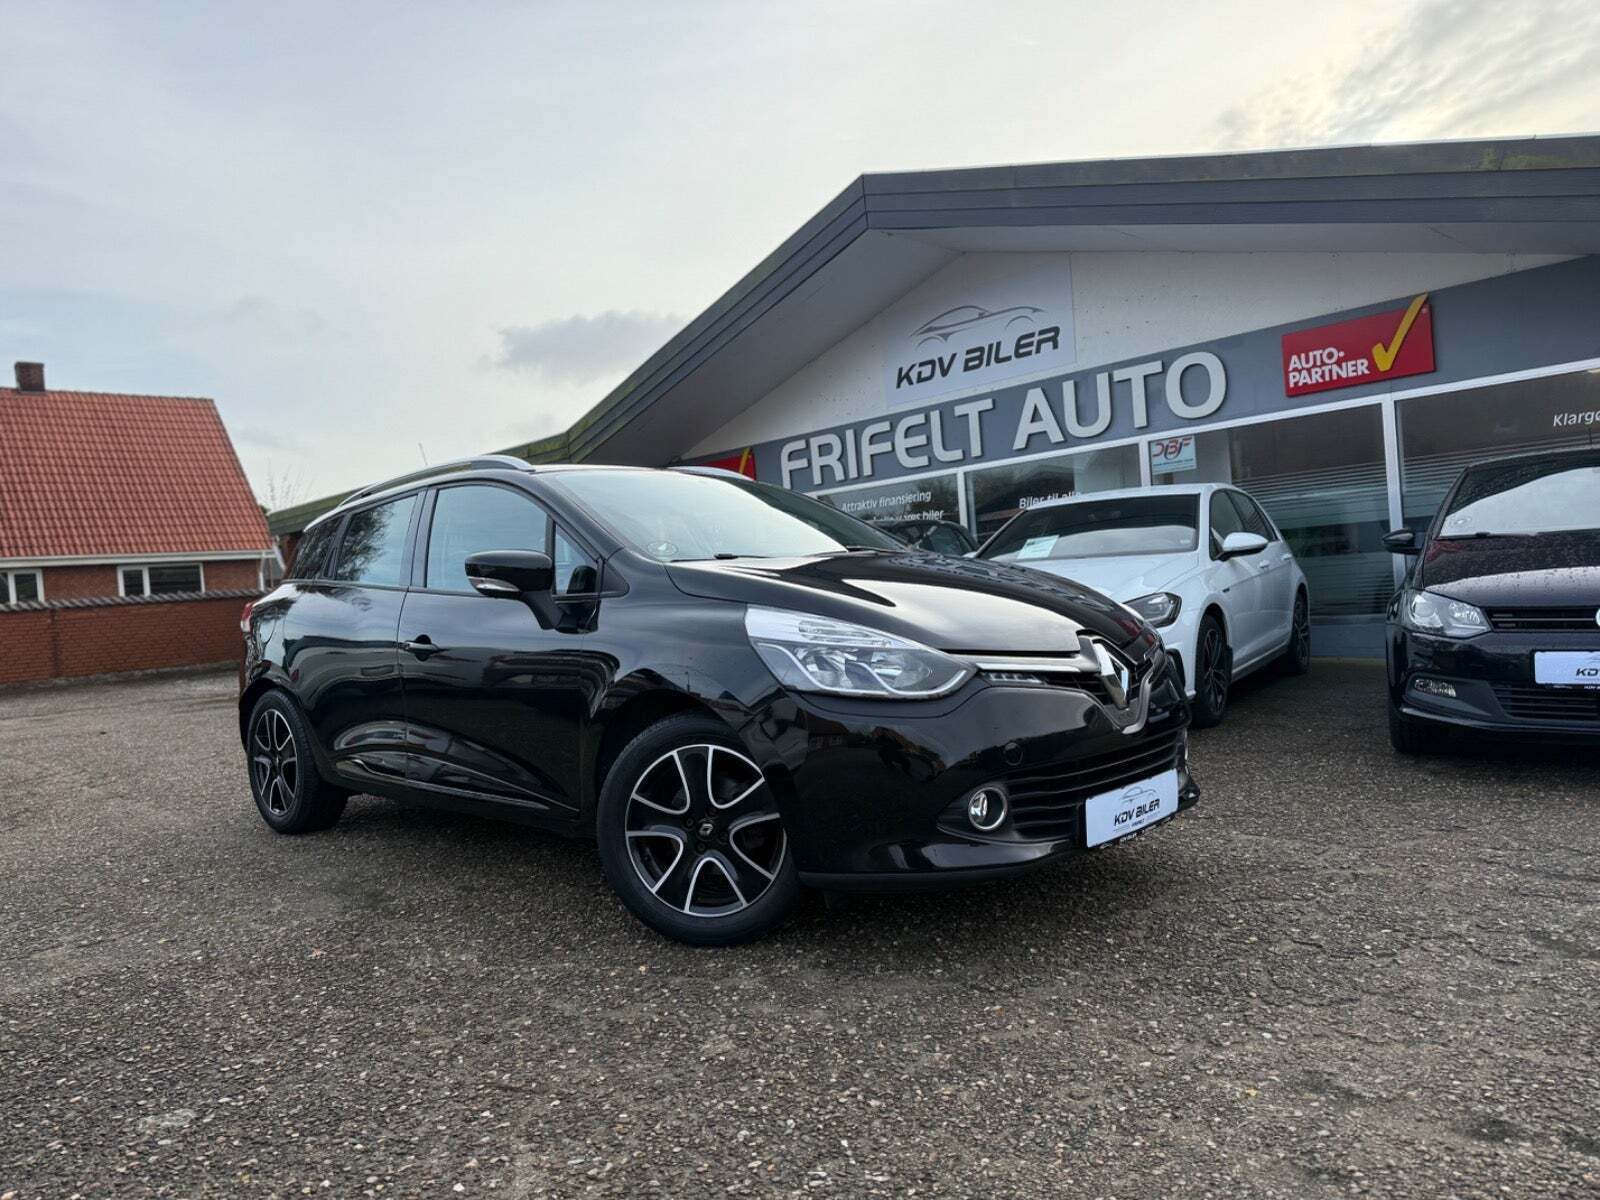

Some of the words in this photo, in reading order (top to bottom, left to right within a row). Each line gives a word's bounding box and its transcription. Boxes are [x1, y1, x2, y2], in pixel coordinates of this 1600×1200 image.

[896, 352, 957, 389] KDV
[963, 325, 1061, 373] BILER
[1288, 358, 1370, 388] PARTNER
[780, 398, 996, 488] FRIFELT
[1013, 351, 1228, 451] AUTO
[1576, 668, 1600, 676] KD
[1114, 808, 1135, 826] KDV
[1135, 798, 1160, 818] BILER
